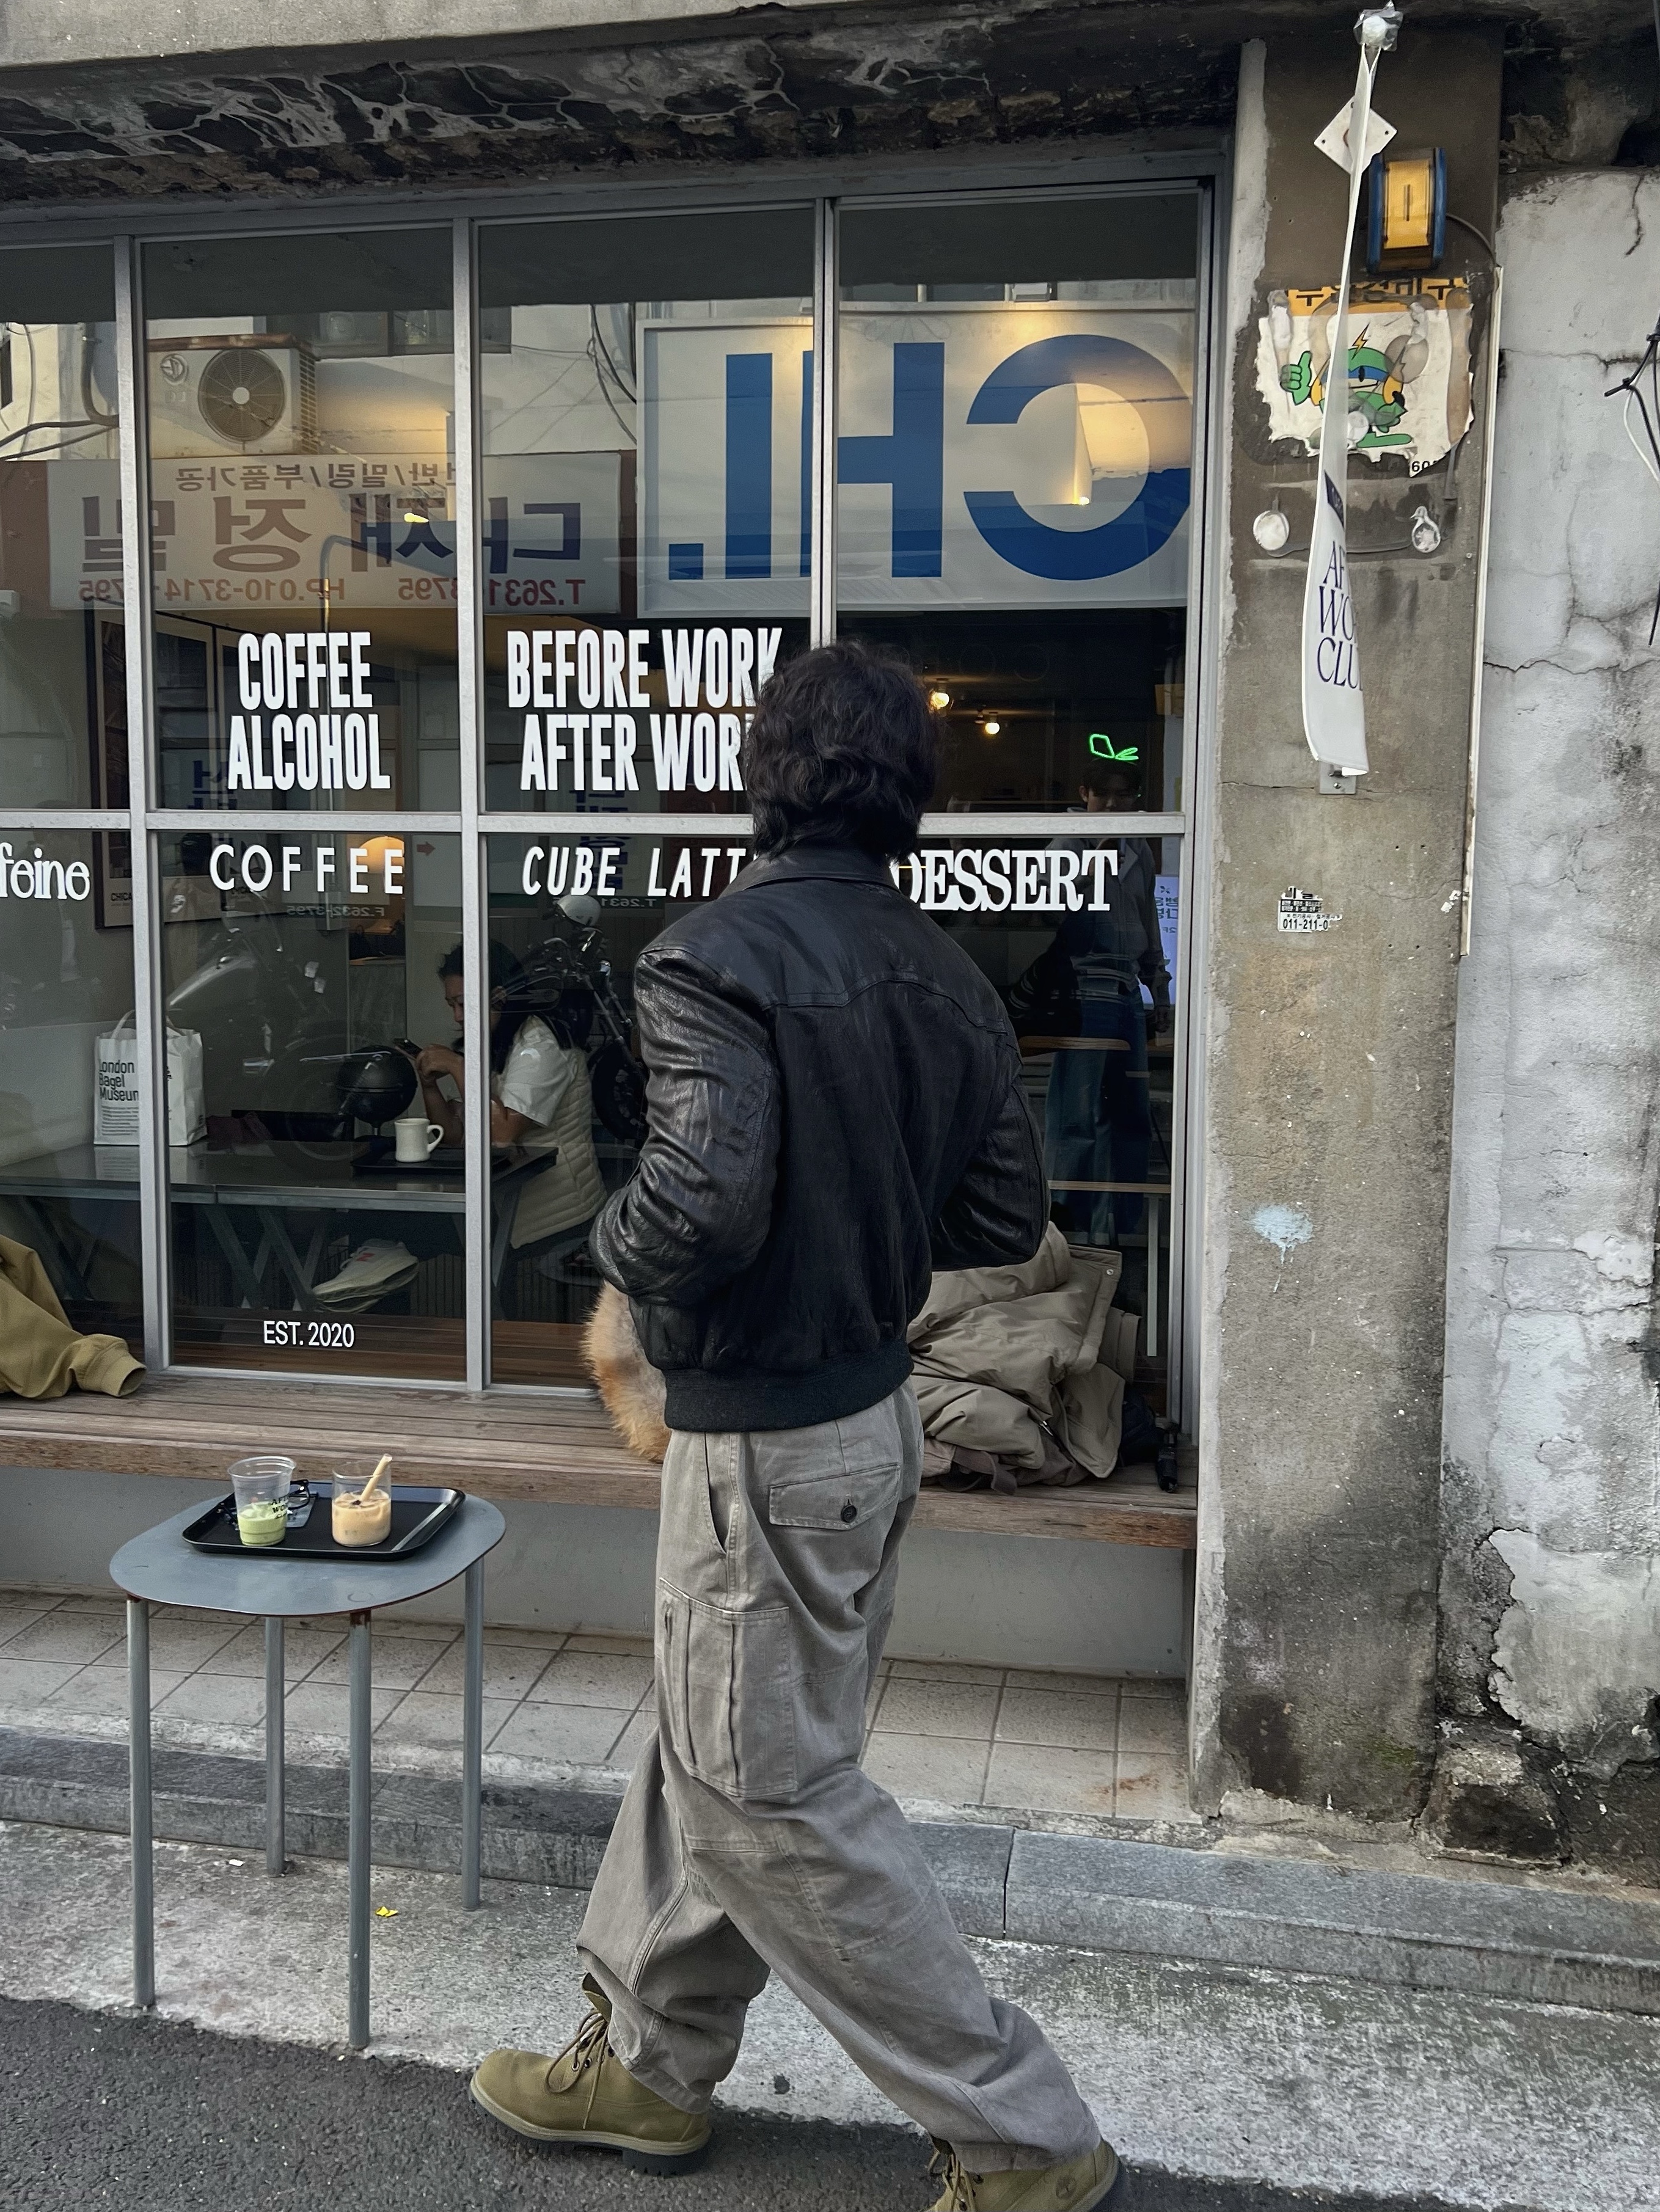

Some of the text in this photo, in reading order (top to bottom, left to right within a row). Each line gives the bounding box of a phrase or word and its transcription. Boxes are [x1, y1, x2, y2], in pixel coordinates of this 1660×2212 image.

[1411, 460, 1438, 472] 60
[1318, 585, 1358, 643] WO
[238, 631, 373, 710] COFFEE
[506, 627, 783, 709] BEFORE WORK
[1317, 637, 1363, 692] CLU
[227, 714, 391, 791] ALCOHOL
[520, 712, 755, 792] AFTER WOR
[210, 843, 405, 894] COFFEE
[522, 845, 759, 898] CUBE LATT
[98, 1073, 126, 1090] Bagel
[99, 1060, 135, 1074] London
[263, 1320, 355, 1348] EST. 2020
